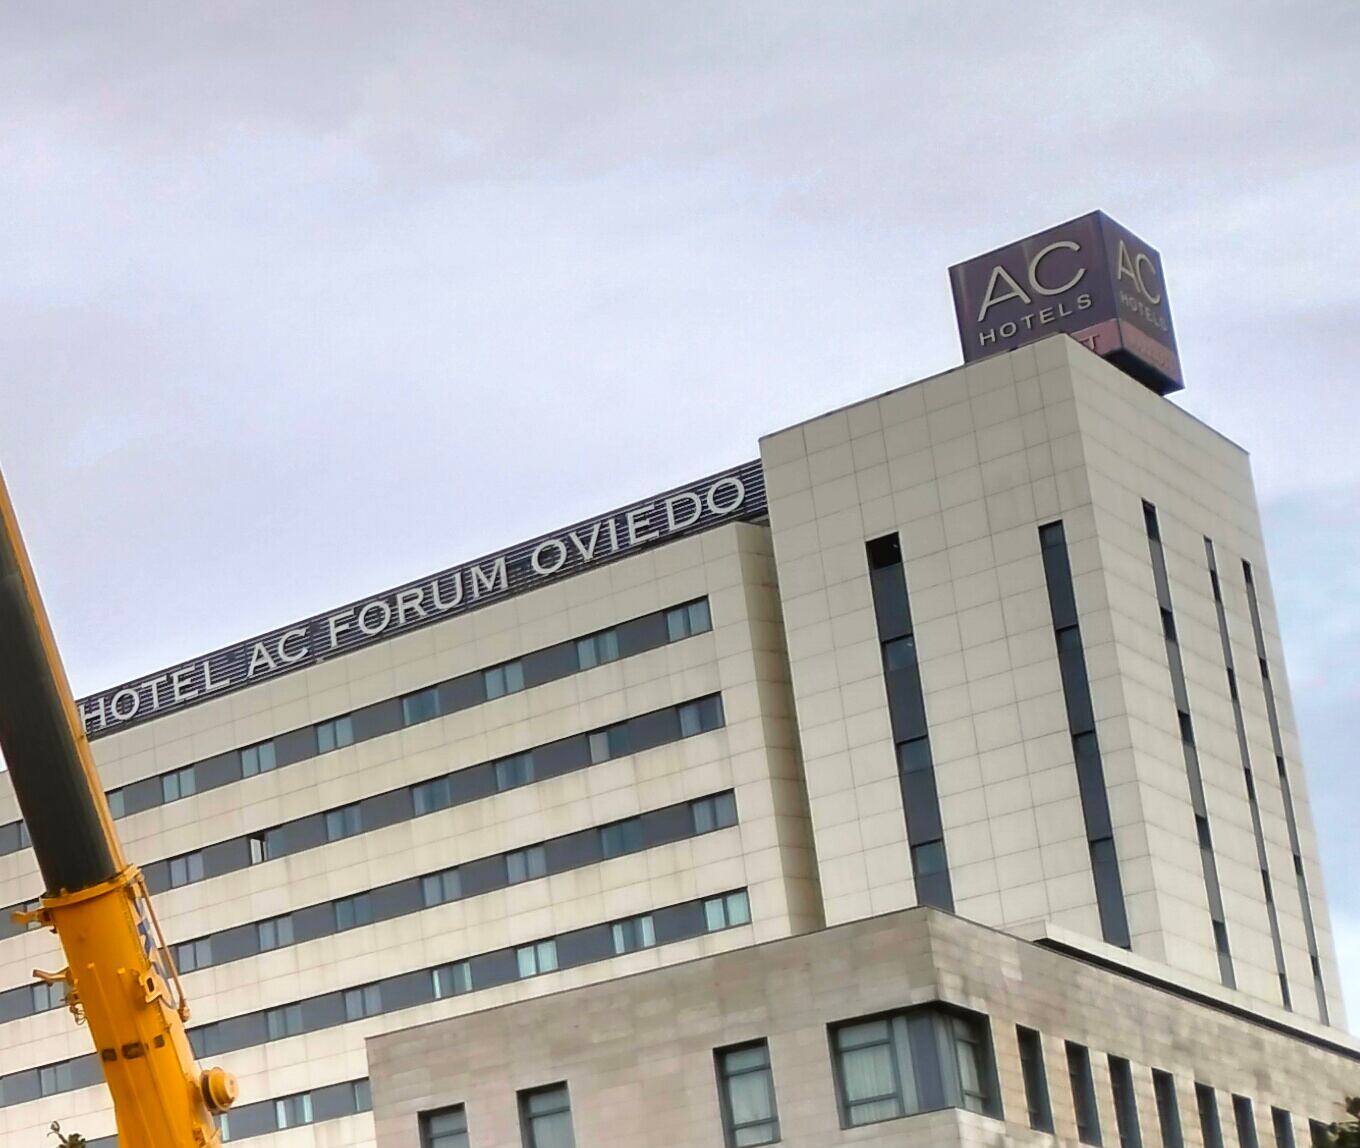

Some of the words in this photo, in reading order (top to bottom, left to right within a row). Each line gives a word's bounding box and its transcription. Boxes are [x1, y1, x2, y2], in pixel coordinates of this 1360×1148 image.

[977, 240, 1087, 322] AC
[1117, 239, 1161, 304] AC
[979, 293, 1093, 346] HOTELS
[80, 657, 230, 735] HOTEL
[247, 624, 309, 678] AC
[327, 556, 510, 649] FORUM
[531, 475, 746, 576] OVIEDO
